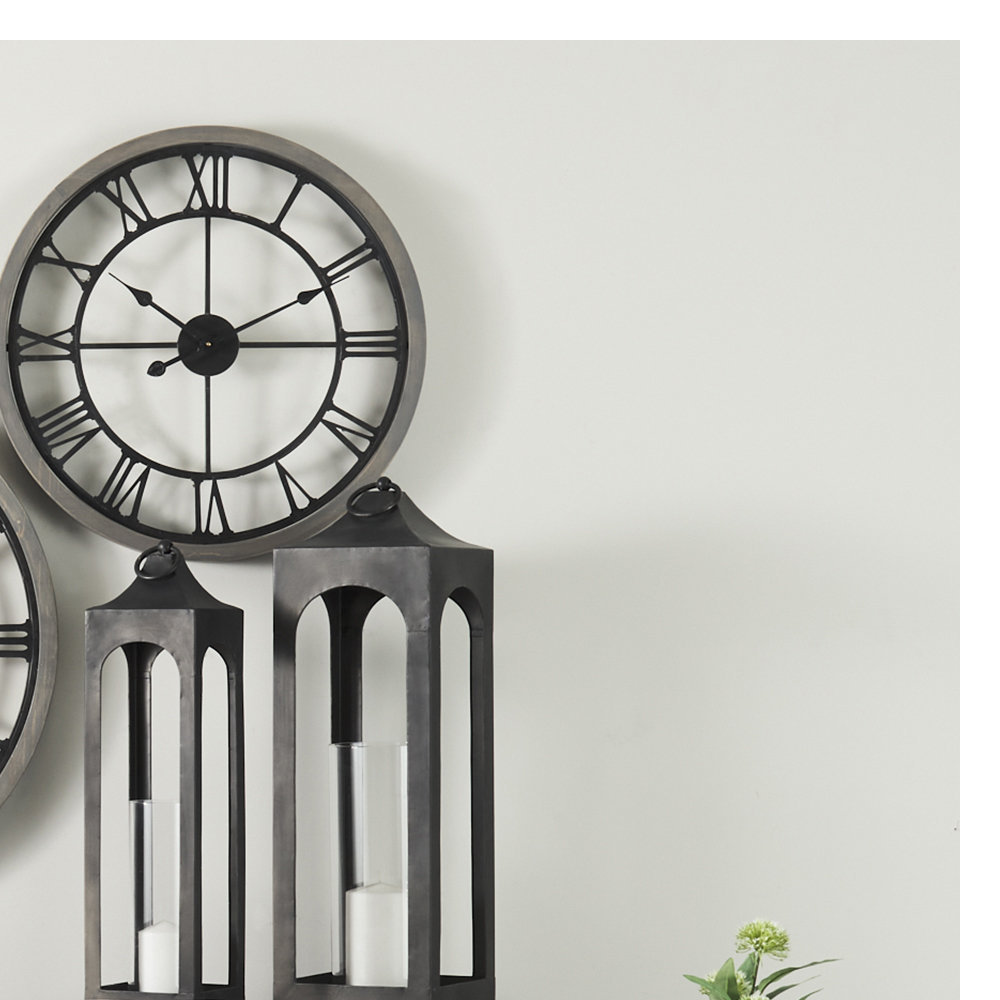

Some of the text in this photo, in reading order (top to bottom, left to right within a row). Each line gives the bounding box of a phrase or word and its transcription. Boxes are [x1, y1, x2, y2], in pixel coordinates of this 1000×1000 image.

[97, 169, 157, 238] XI
[182, 153, 233, 214] XII
[35, 236, 100, 290] X
[340, 326, 399, 360] III
[321, 400, 381, 461] IV
[95, 448, 151, 521] VII
[192, 477, 233, 535] VI
